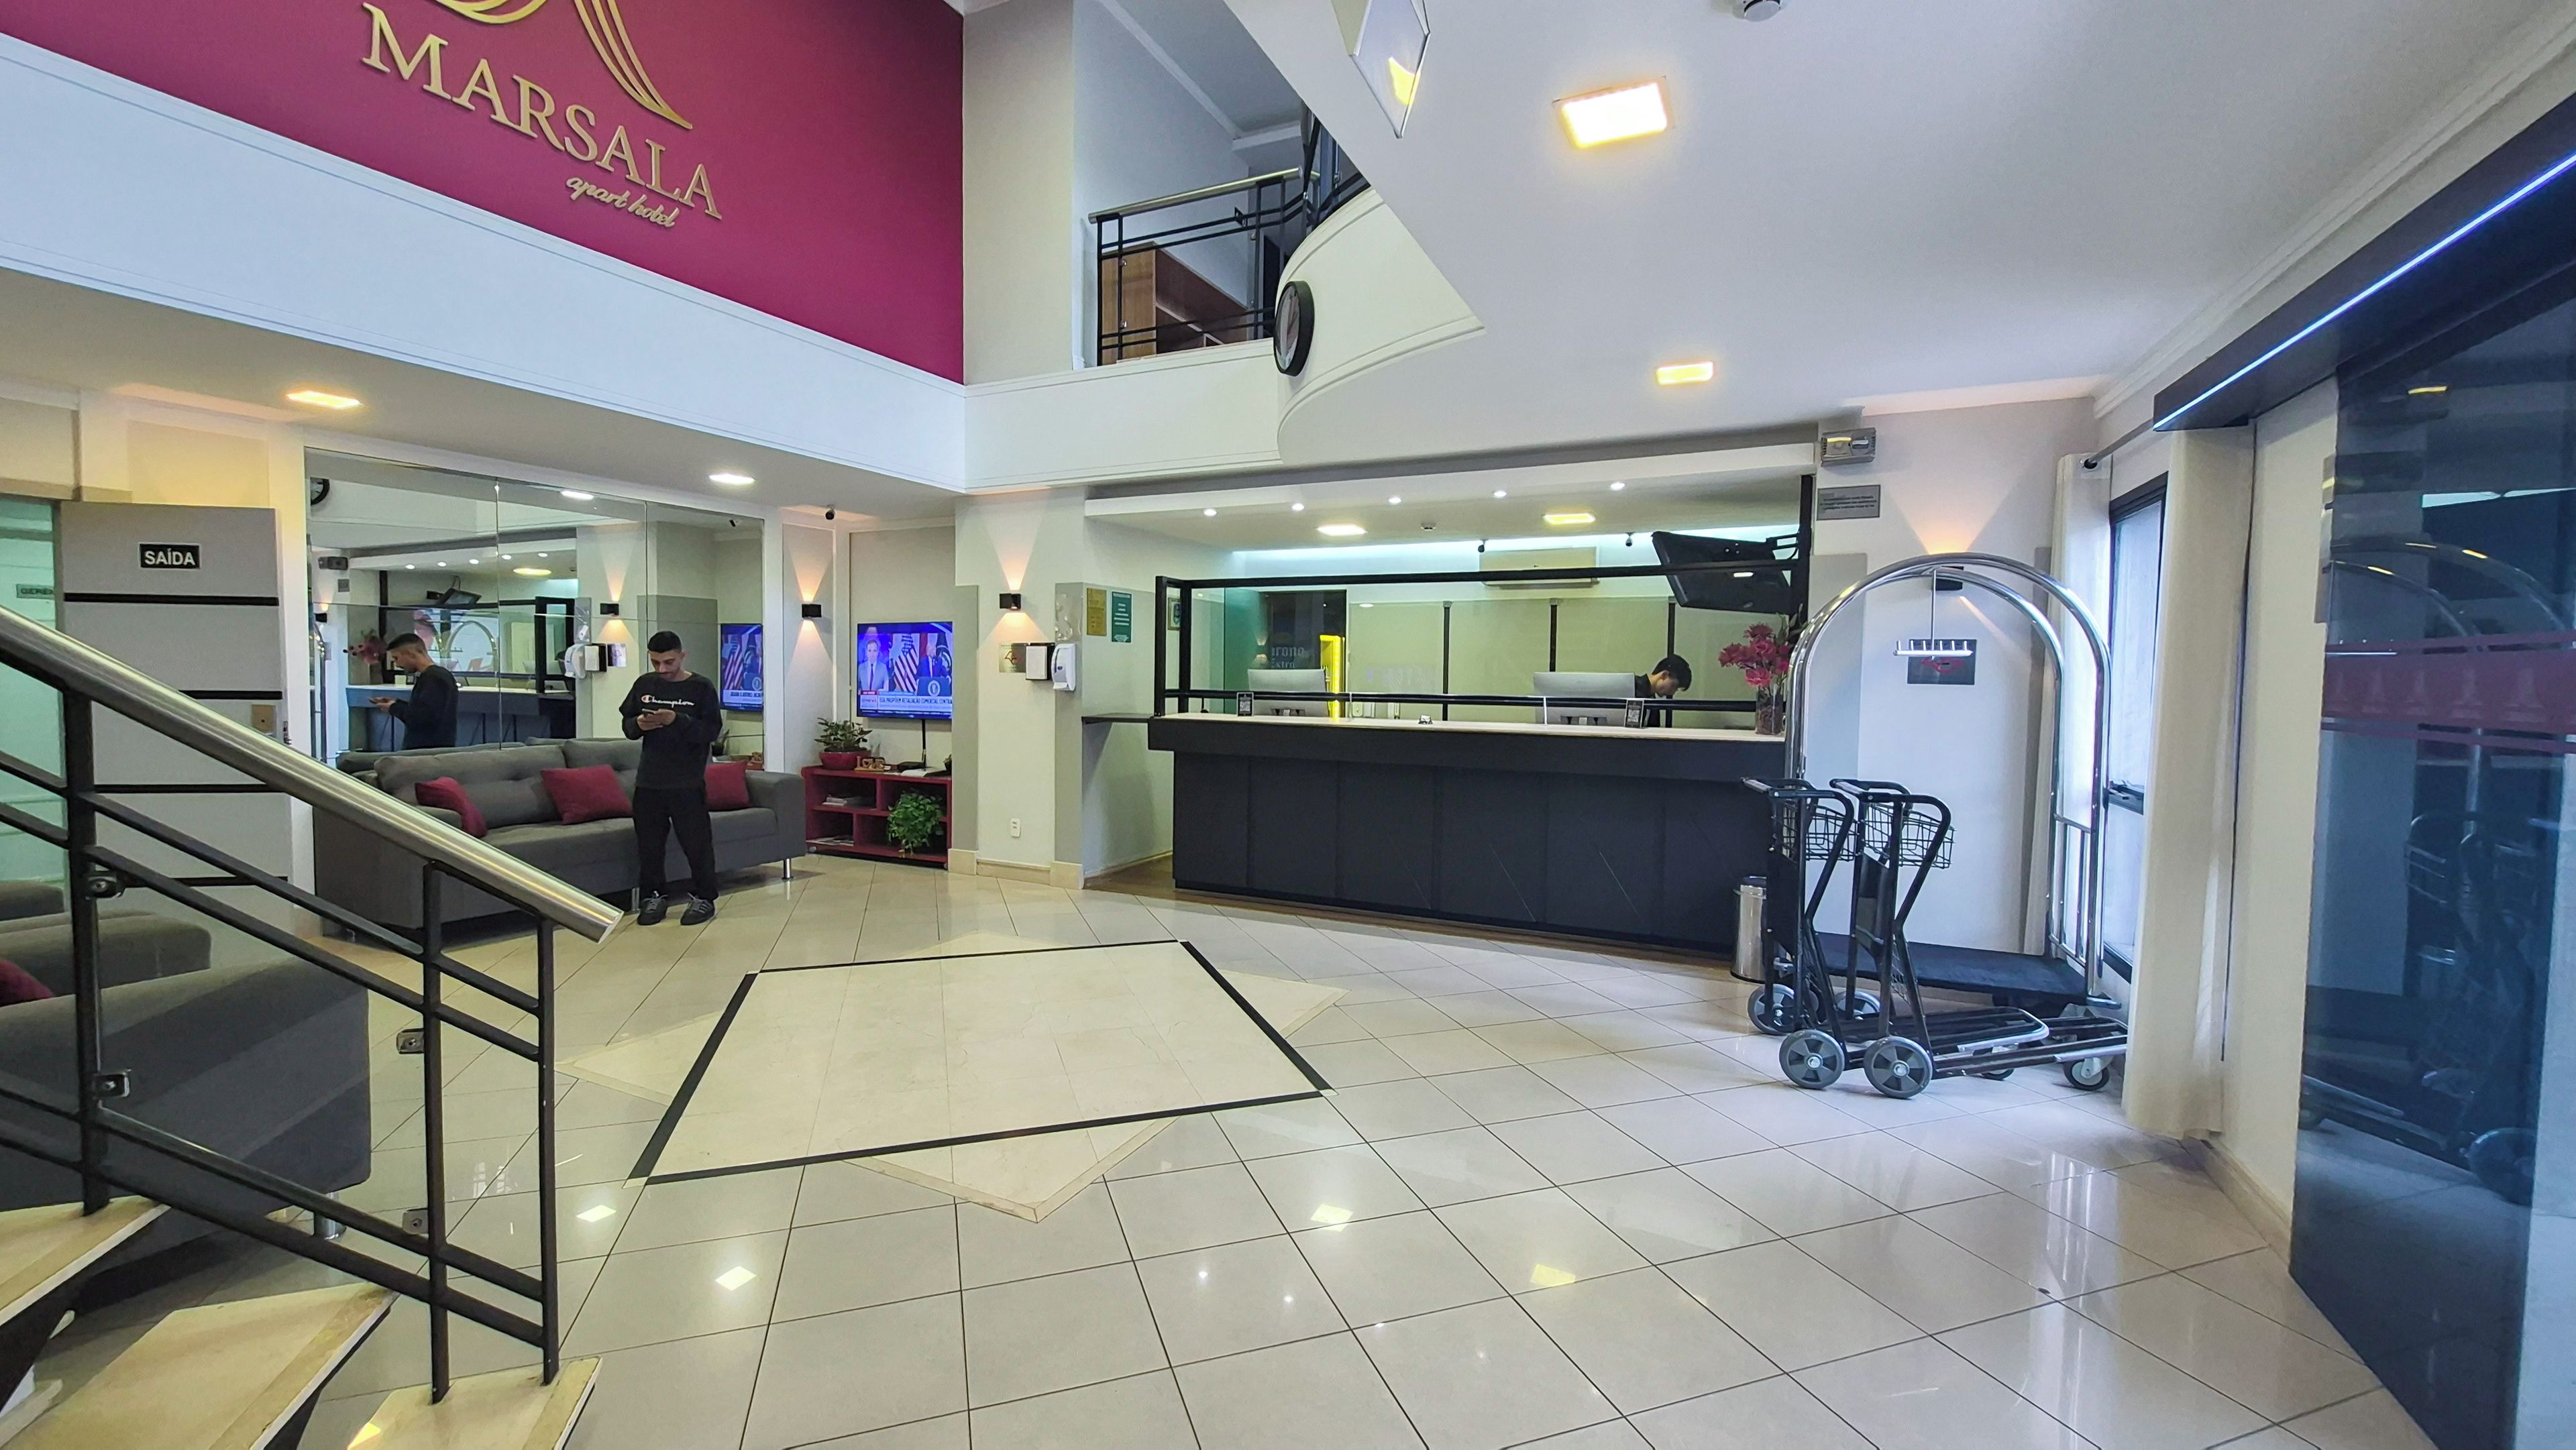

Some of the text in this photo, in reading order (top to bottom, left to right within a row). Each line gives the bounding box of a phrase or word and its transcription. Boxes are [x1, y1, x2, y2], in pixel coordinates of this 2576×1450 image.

[362, 2, 722, 220] MARSALA
[566, 177, 680, 228] apart hotel
[144, 548, 196, 565] SAÍDA
[641, 694, 695, 709] Champion
